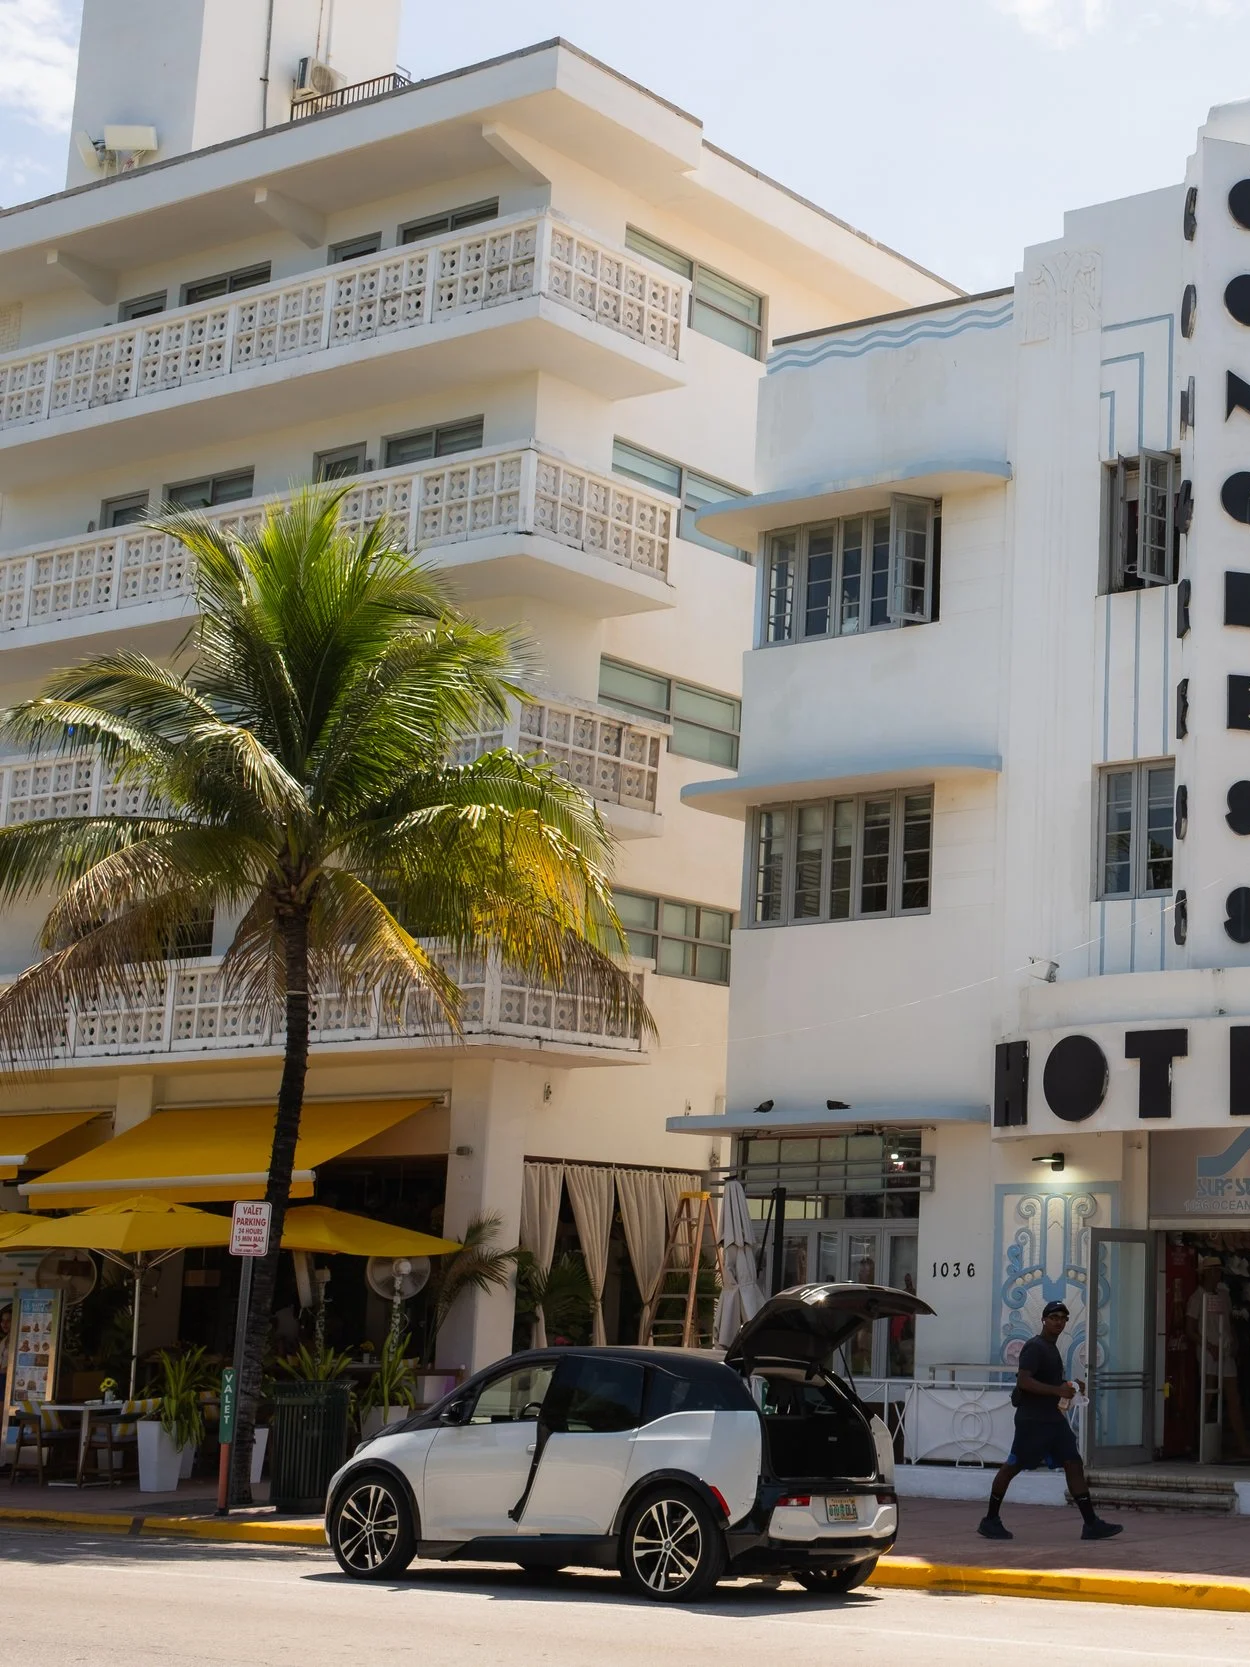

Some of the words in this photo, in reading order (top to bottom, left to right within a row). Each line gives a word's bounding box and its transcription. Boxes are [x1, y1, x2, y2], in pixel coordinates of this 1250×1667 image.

[243, 1205, 263, 1215] VALET
[236, 1217, 267, 1227] PARKING
[930, 1261, 977, 1278] 1036
[224, 1374, 233, 1425] VALET
